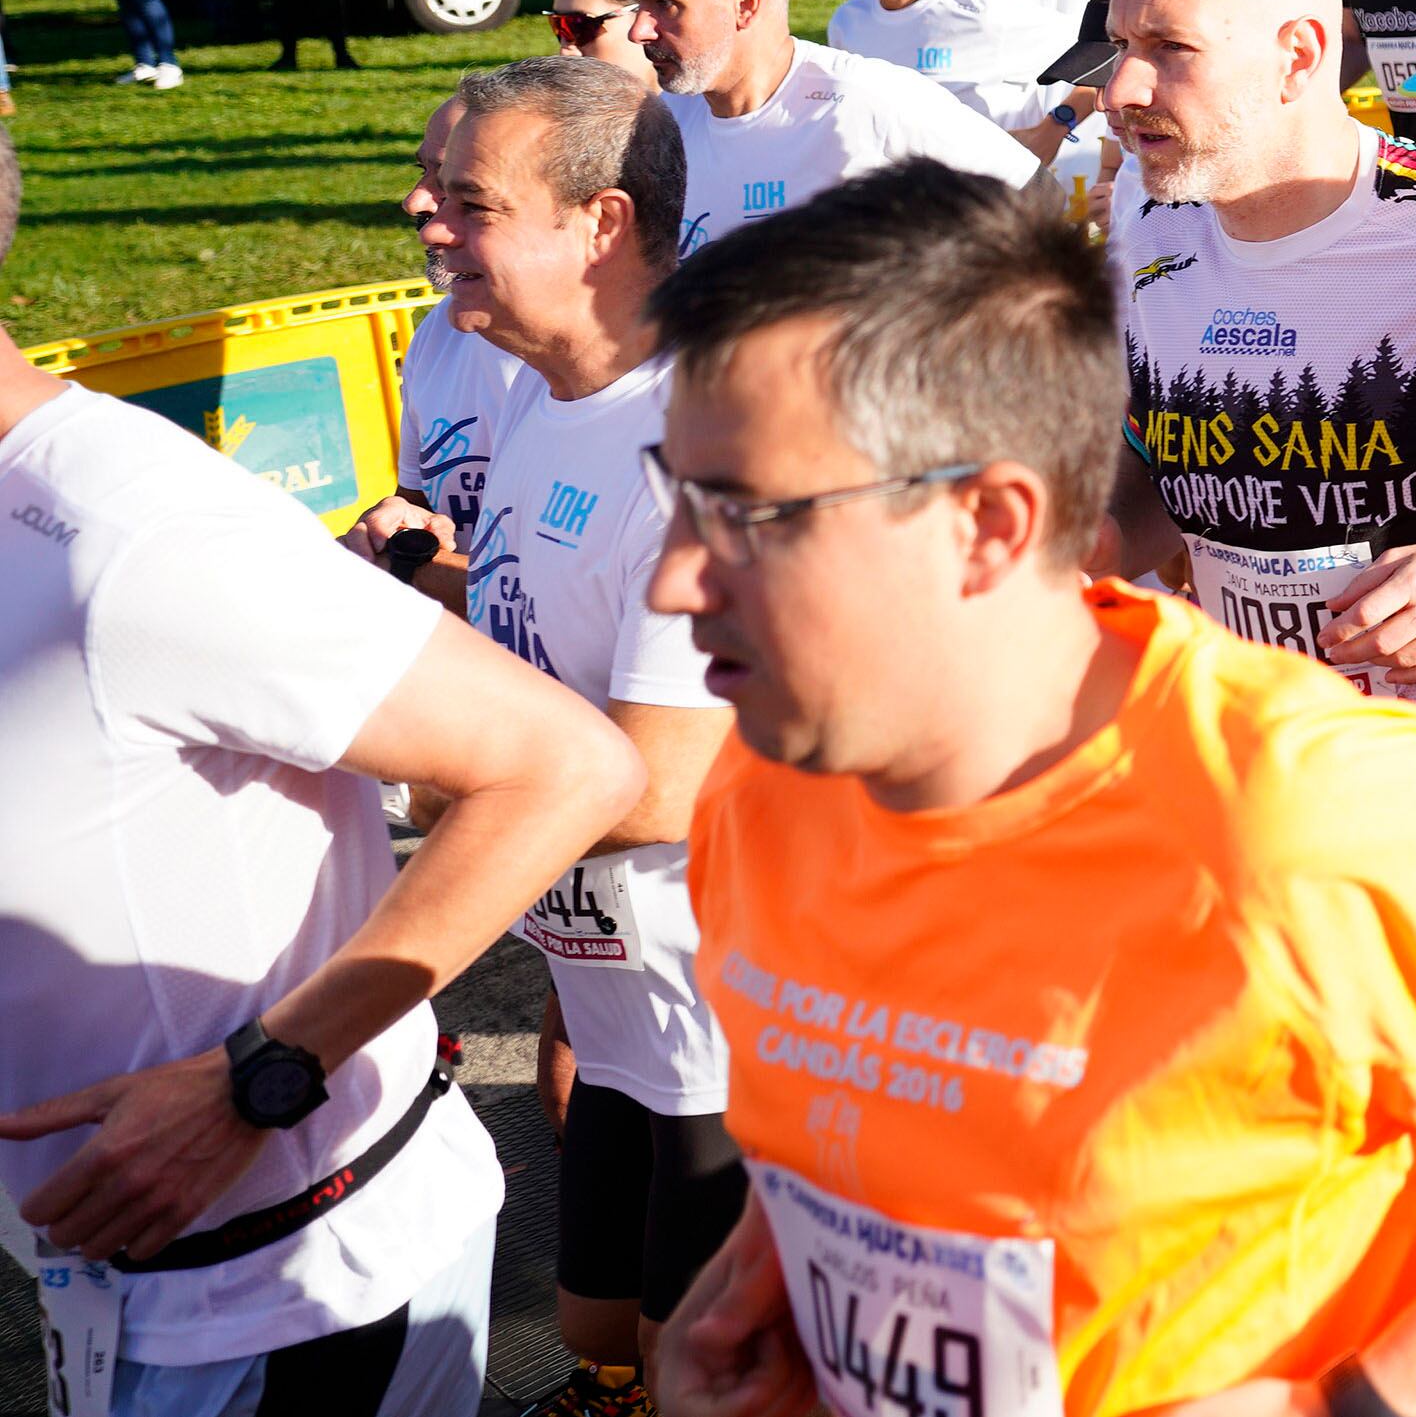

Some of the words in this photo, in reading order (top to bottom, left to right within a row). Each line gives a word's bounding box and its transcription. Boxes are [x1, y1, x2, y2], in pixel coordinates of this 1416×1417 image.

[1201, 323, 1298, 348] Aescala
[1213, 308, 1278, 326] coches
[1145, 408, 1241, 471] MENS
[1252, 418, 1403, 480] SANA
[1206, 544, 1250, 570] CARRERA
[1250, 555, 1297, 577] HUCA
[1297, 556, 1336, 572] 2023
[564, 939, 581, 956] LA
[582, 940, 623, 957] SALUD
[779, 979, 845, 1030] POR
[844, 999, 890, 1044] LA
[894, 1012, 1089, 1089] ESCLEROSIS
[886, 1063, 965, 1113] 2016
[854, 1214, 931, 1266] HUCA
